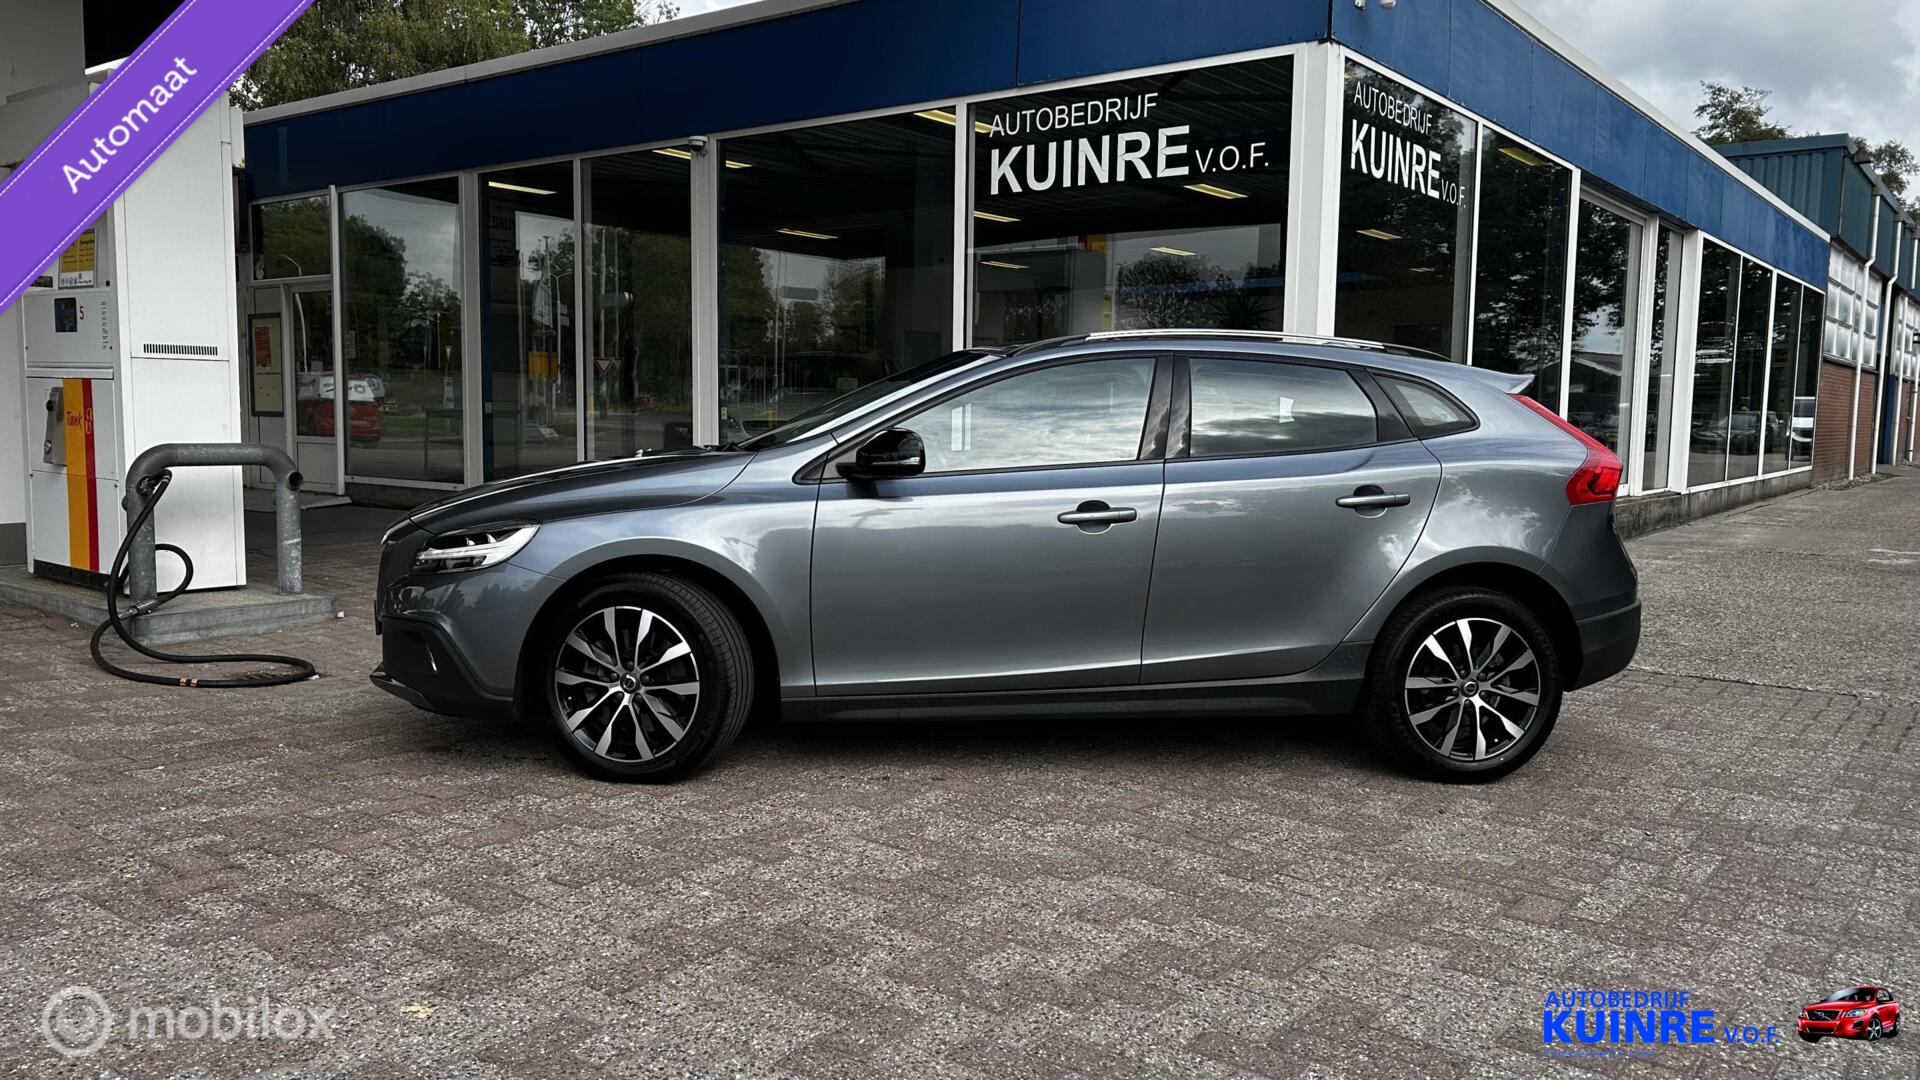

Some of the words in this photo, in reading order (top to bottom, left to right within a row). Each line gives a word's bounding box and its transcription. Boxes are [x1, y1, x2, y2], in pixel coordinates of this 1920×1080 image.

[989, 92, 1159, 138] AUTOBEDRIJF
[1353, 80, 1433, 135] AUTOBEDRIJF
[990, 124, 1190, 196] KUINRE
[1195, 141, 1270, 174] V.O.F.
[1350, 118, 1442, 200] KUINRE
[1441, 178, 1467, 209] V.O.F.
[79, 305, 85, 320] 5
